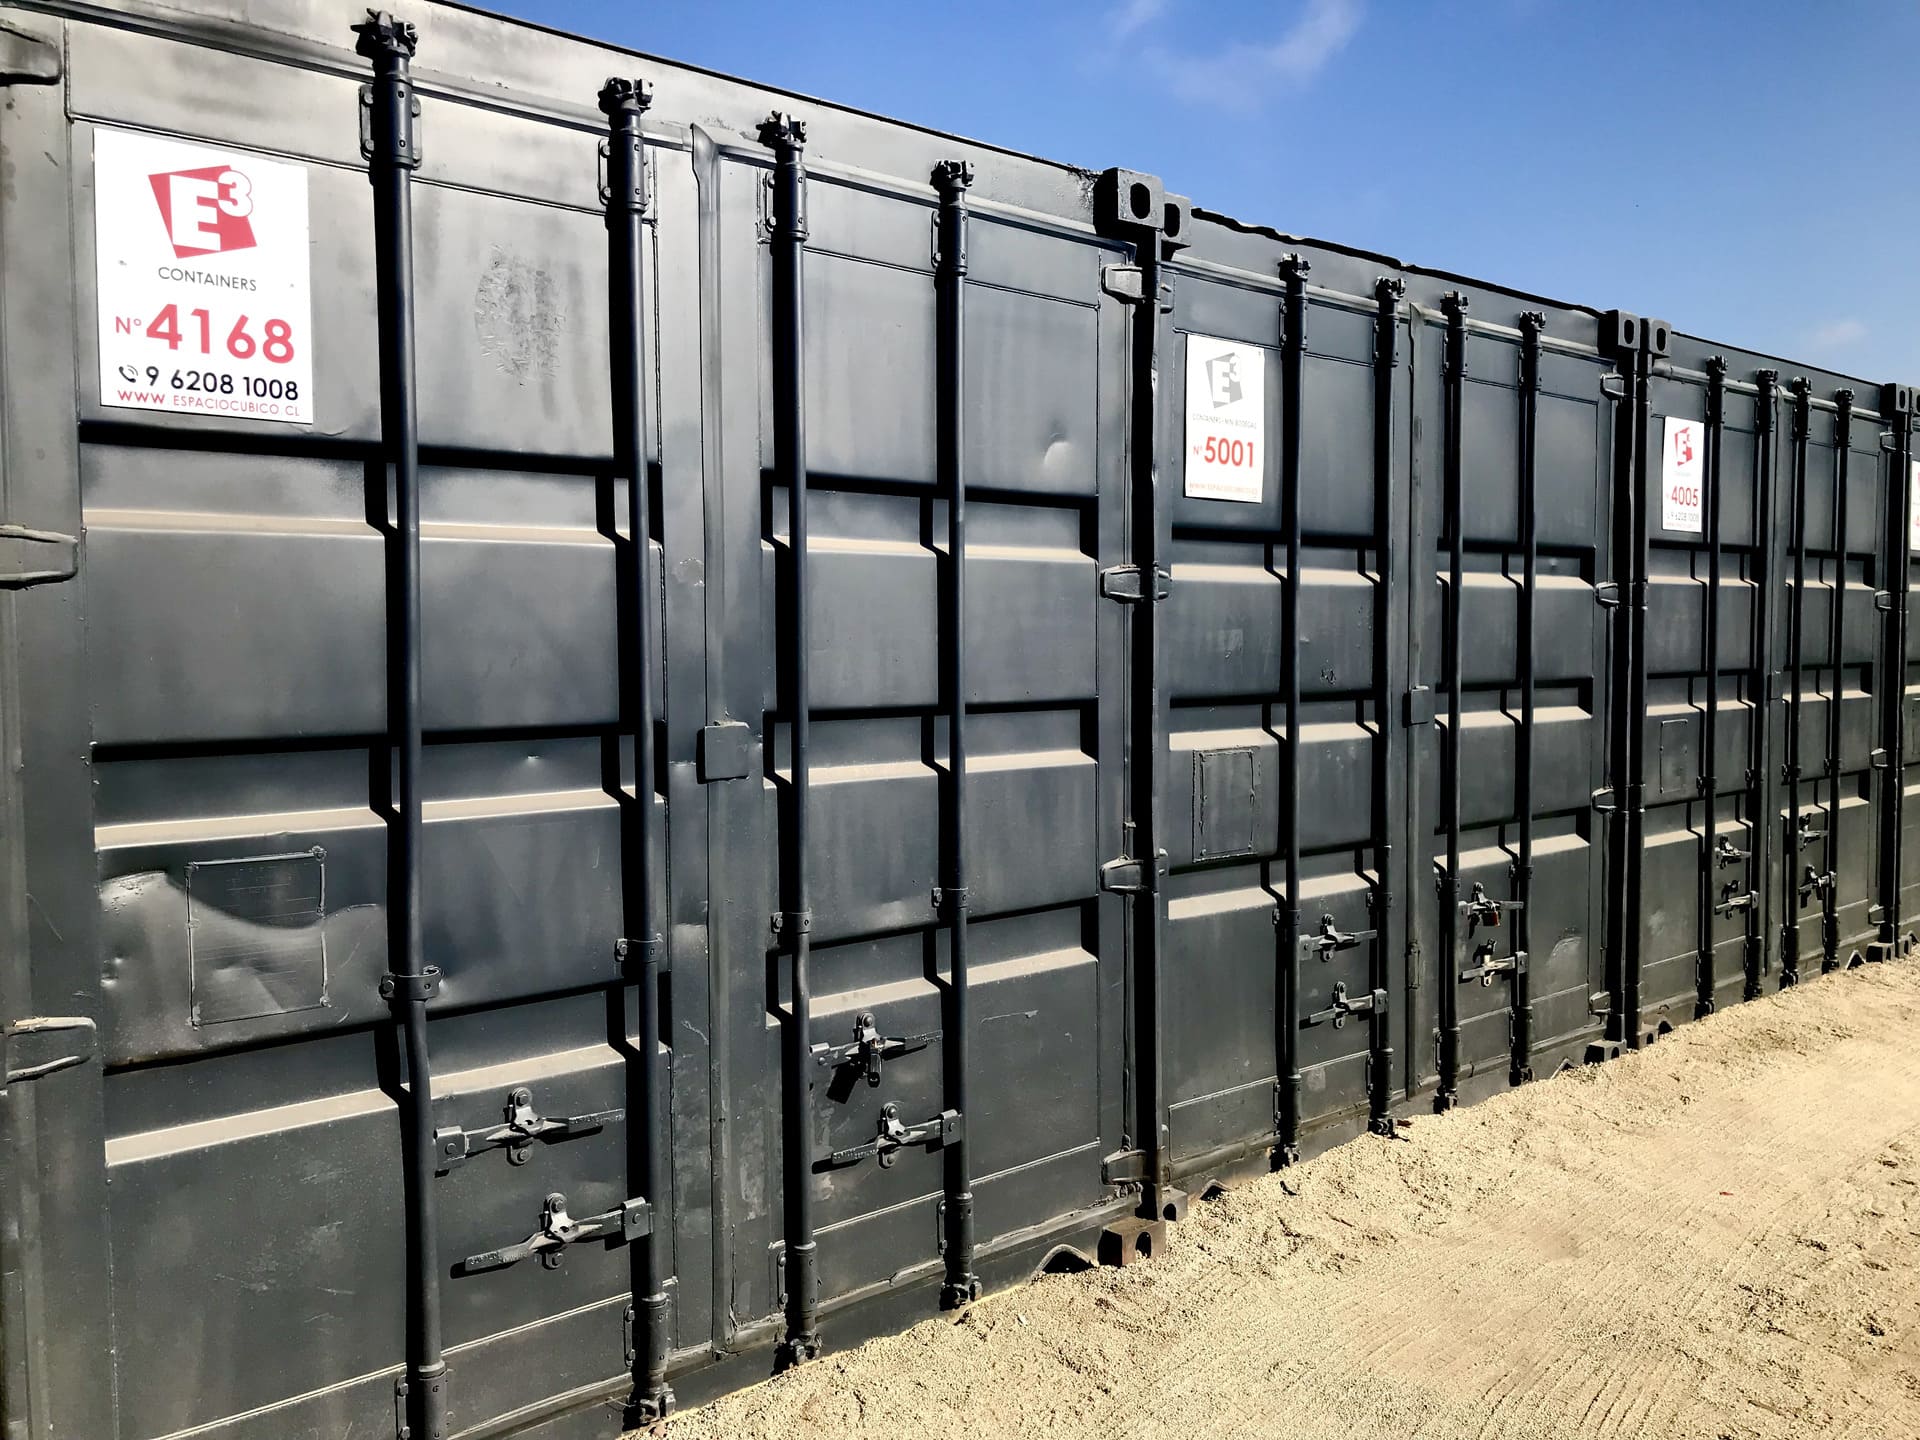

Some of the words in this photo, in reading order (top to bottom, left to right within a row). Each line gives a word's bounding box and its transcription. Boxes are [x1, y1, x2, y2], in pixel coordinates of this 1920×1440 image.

[157, 266, 257, 292] CONTAINERS
[146, 303, 295, 364] 4168
[145, 365, 160, 387] 9
[170, 369, 234, 395] 6208
[242, 376, 299, 401] 1008
[1204, 437, 1254, 468] 5001
[1672, 486, 1699, 507] 4005
